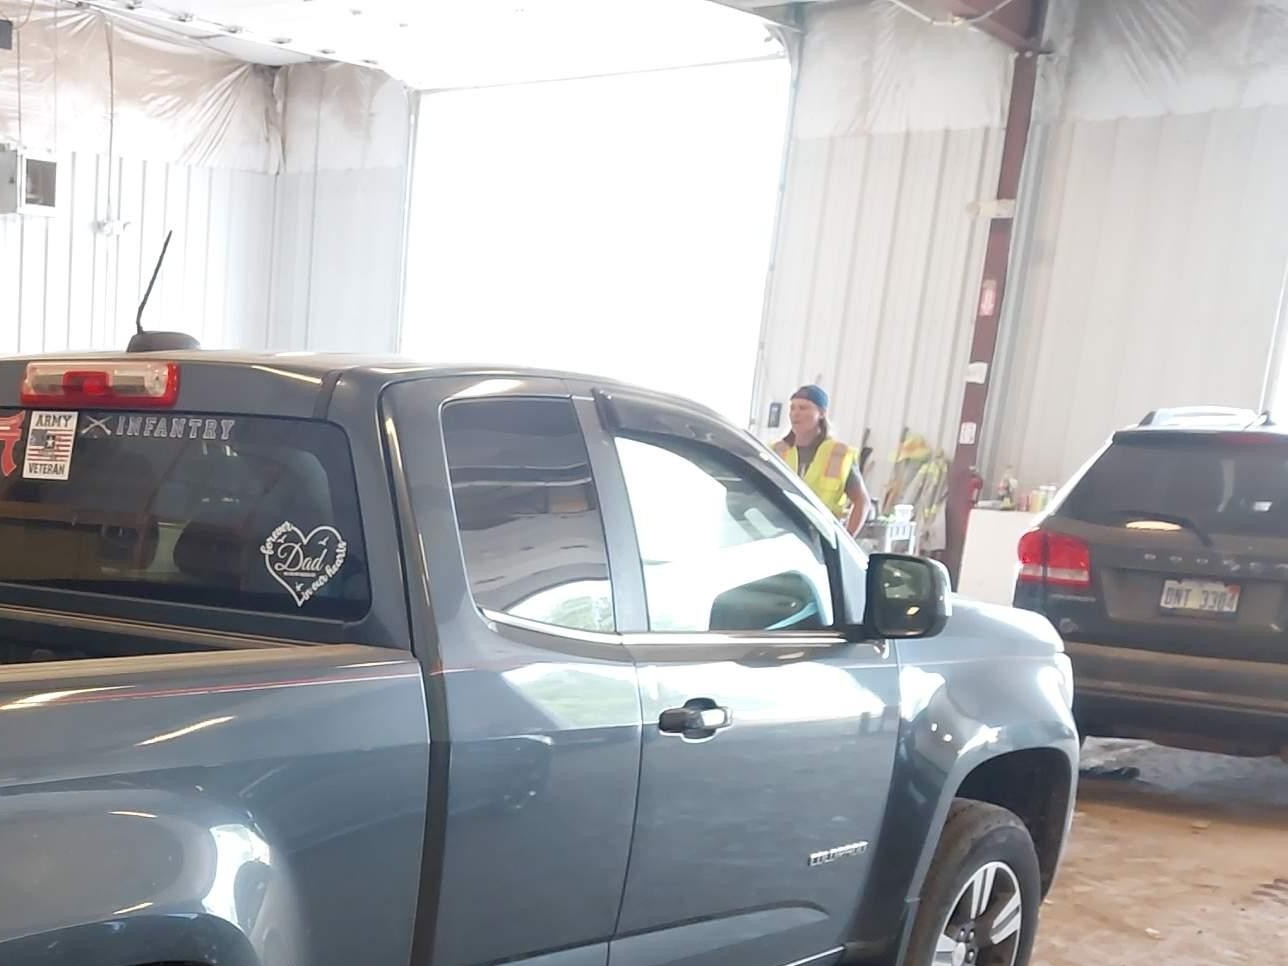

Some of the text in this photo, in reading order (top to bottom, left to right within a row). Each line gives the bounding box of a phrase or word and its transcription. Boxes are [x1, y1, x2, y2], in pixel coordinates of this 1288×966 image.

[35, 414, 72, 428] ARMY
[116, 415, 235, 440] INFANTRY
[27, 463, 66, 476] VETERAN
[274, 542, 328, 572] Dad
